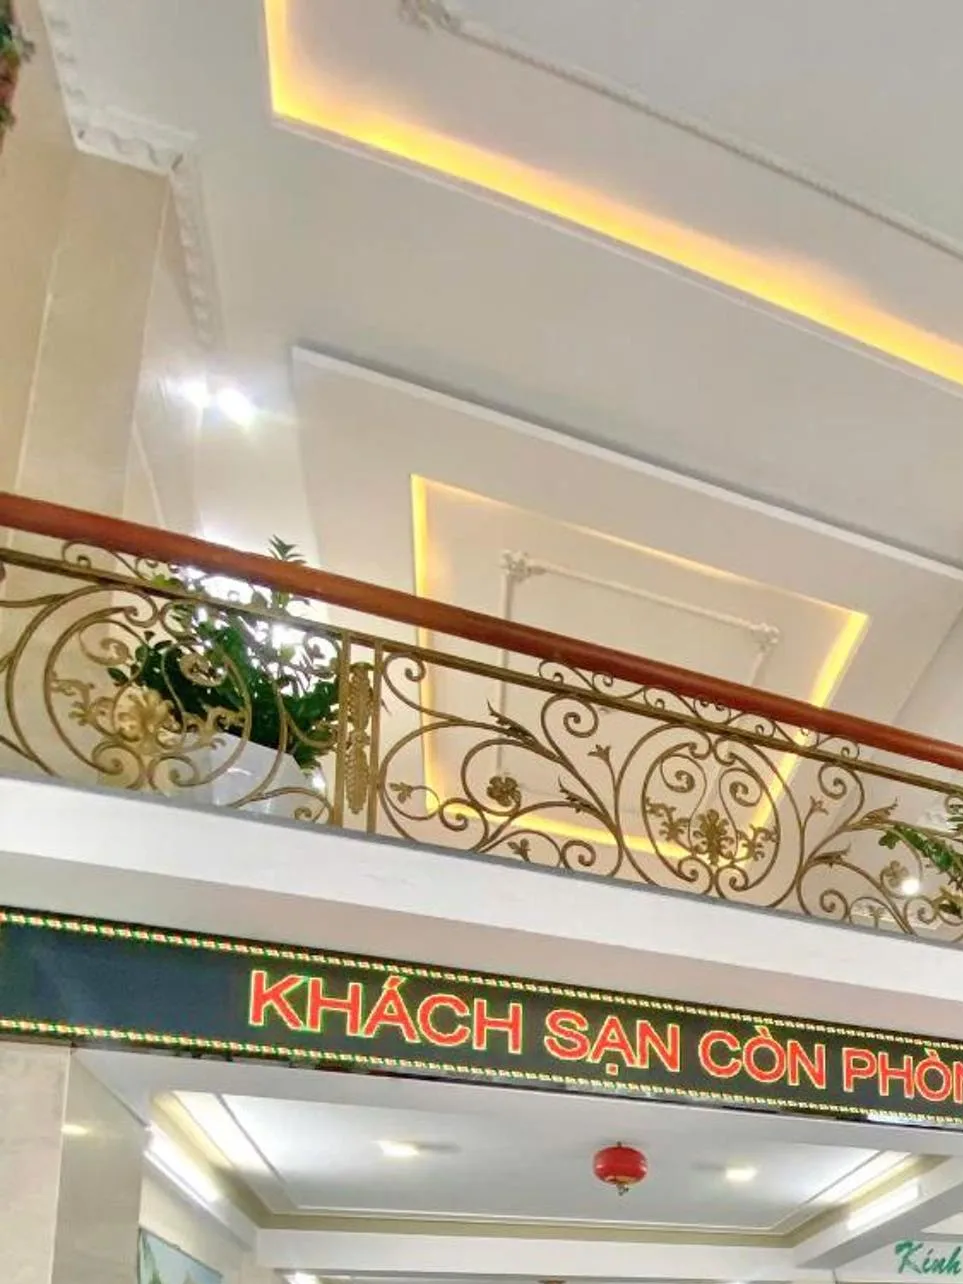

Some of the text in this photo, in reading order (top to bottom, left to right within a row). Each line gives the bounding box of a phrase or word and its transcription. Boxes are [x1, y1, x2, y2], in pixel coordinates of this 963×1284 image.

[249, 969, 523, 1056] KHÁCH
[543, 1009, 681, 1077] SẠN
[698, 1024, 827, 1090] CÒN
[895, 1240, 963, 1275] Kính
